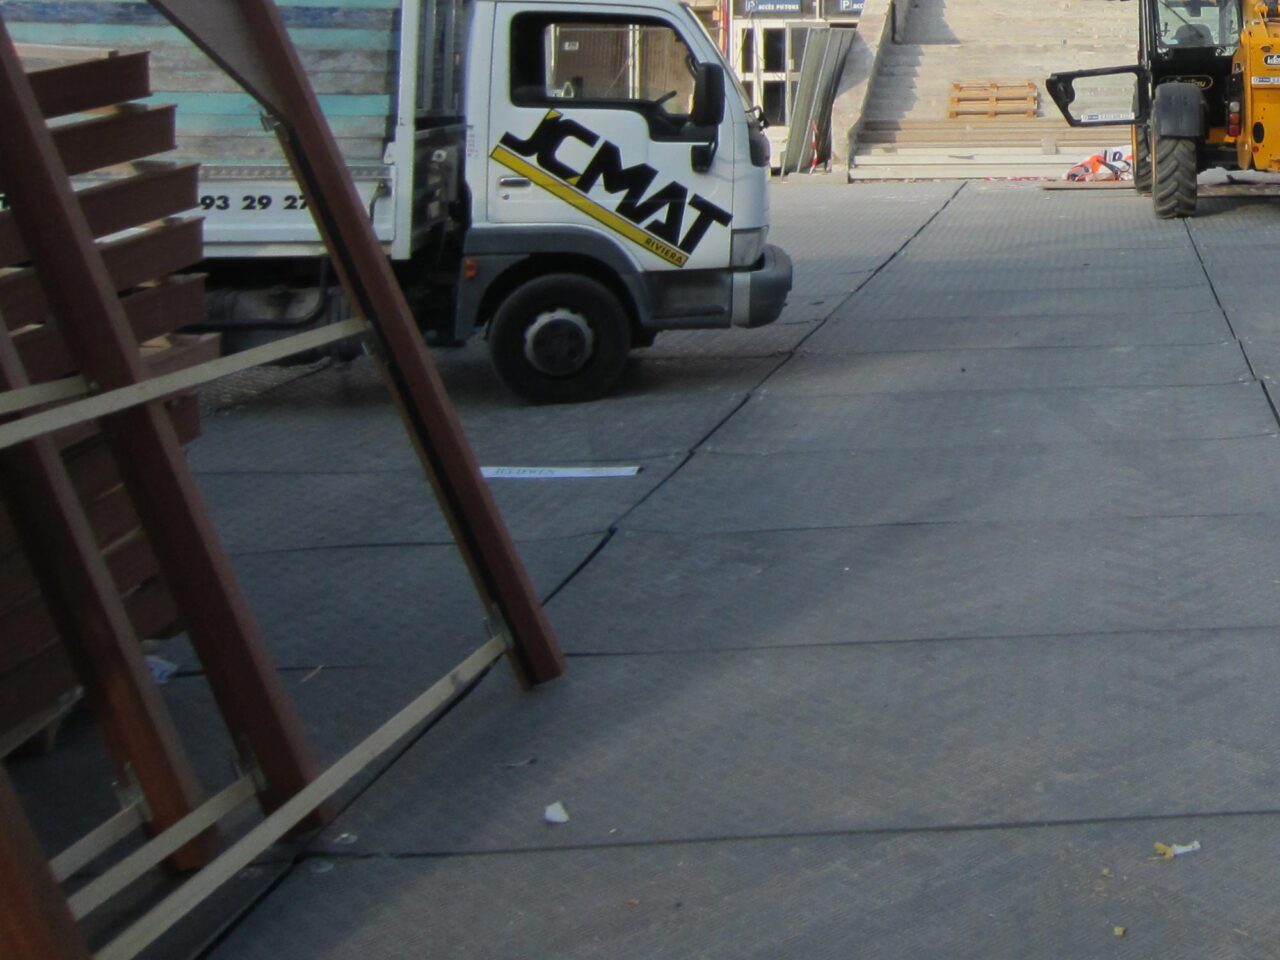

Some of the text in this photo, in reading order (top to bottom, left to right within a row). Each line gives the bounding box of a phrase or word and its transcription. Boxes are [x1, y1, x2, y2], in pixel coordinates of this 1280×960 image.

[499, 108, 733, 255] JCMAT
[200, 195, 230, 210] 93
[241, 195, 272, 210] 29
[644, 238, 684, 263] RIVIERA
